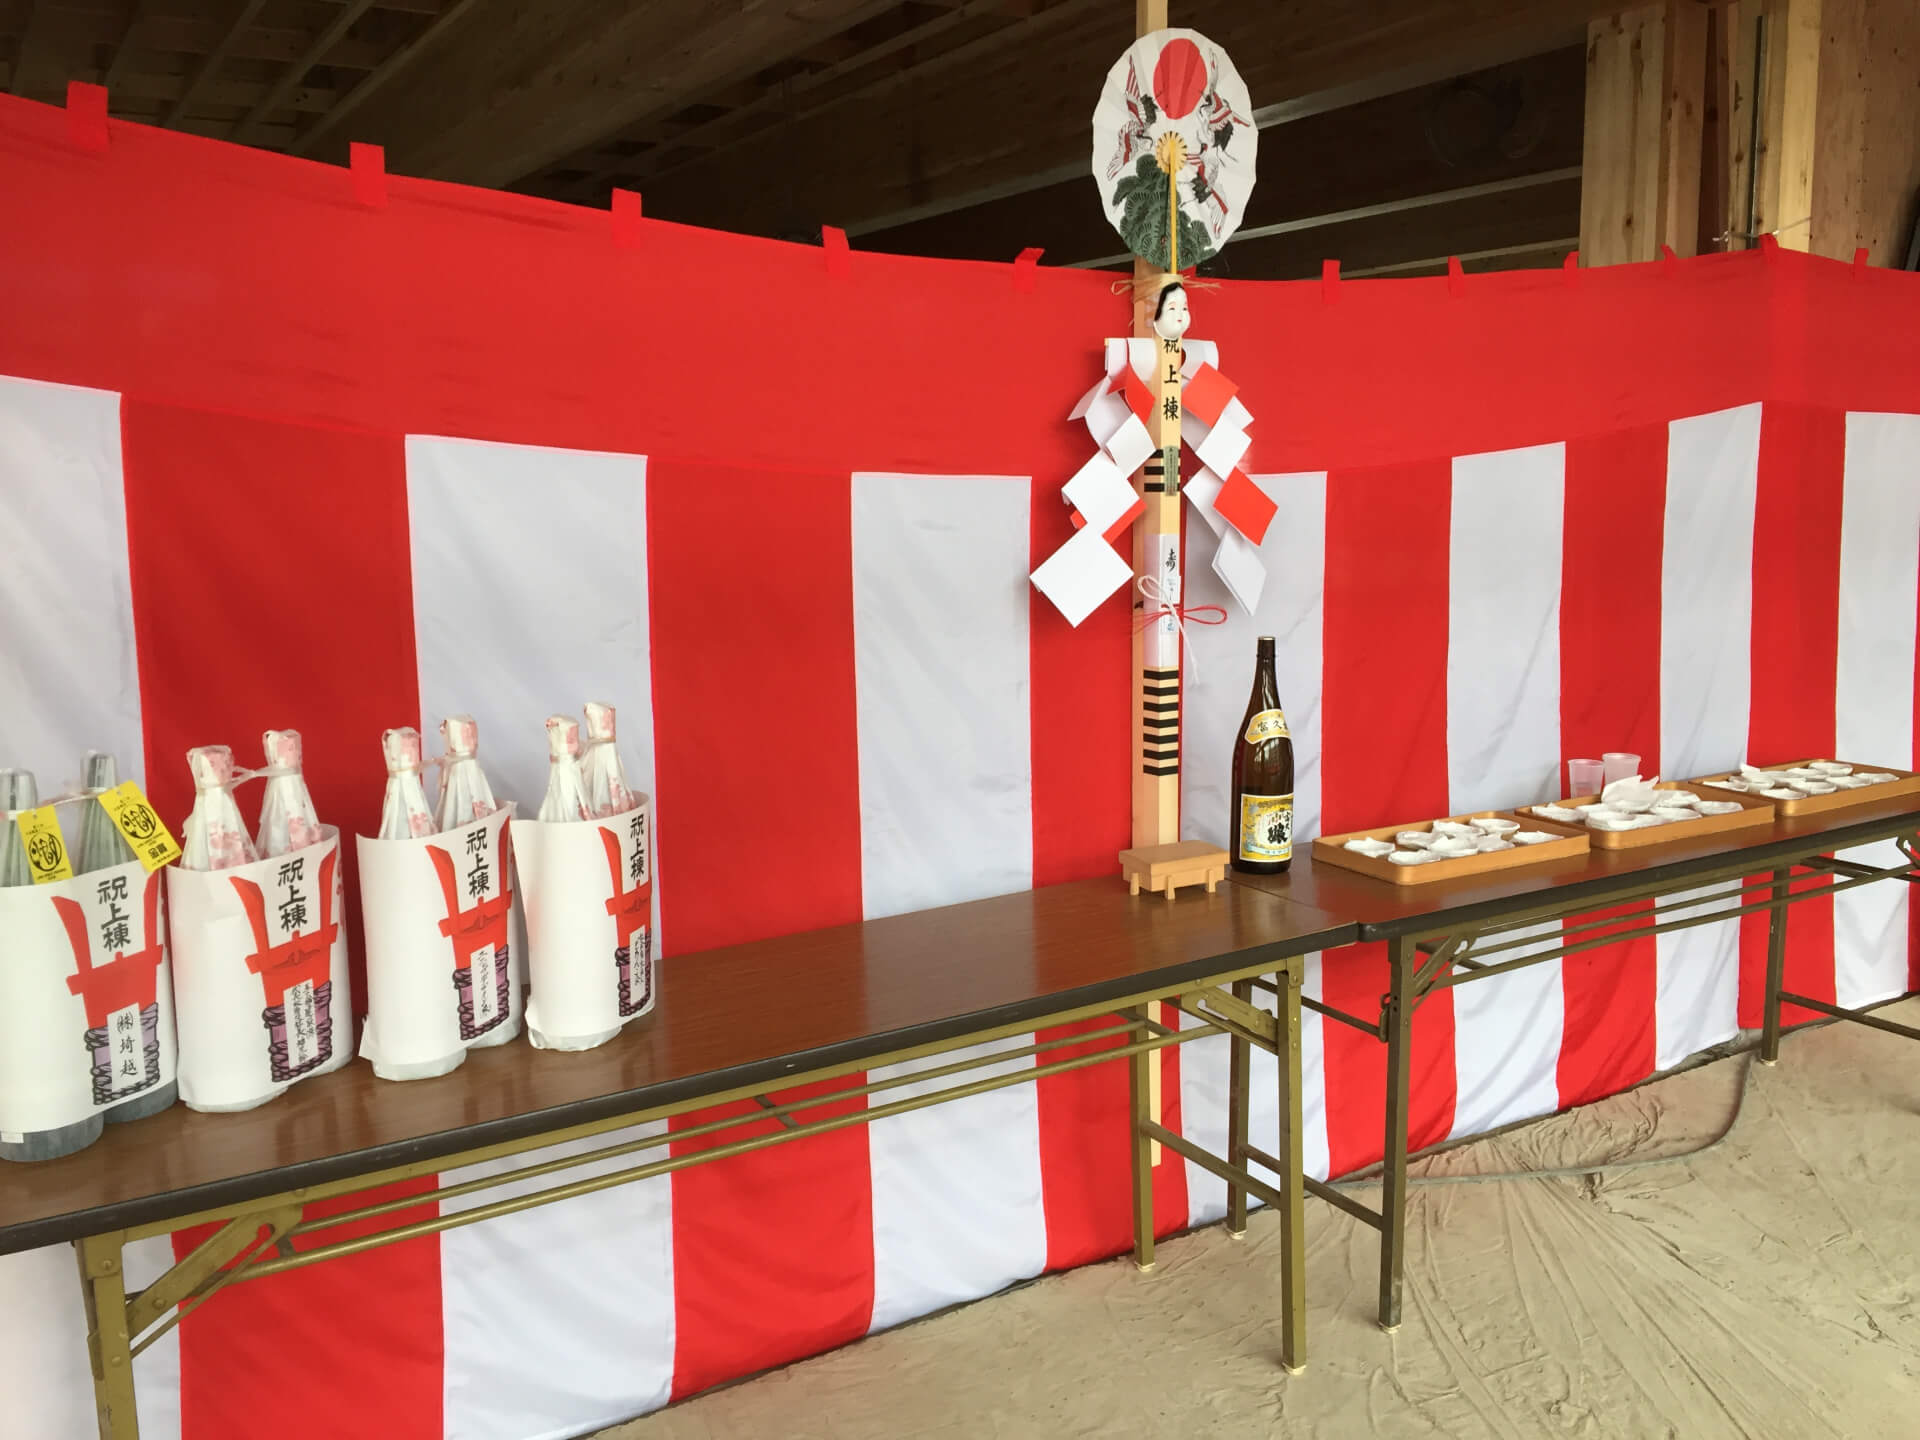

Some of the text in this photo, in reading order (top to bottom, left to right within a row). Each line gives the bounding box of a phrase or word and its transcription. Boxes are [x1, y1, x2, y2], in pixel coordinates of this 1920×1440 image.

[466, 826, 490, 898] 祝上棟
[629, 813, 645, 881] 祝上棟
[97, 875, 131, 952] 祝上棟
[278, 856, 308, 933] 祝上棟
